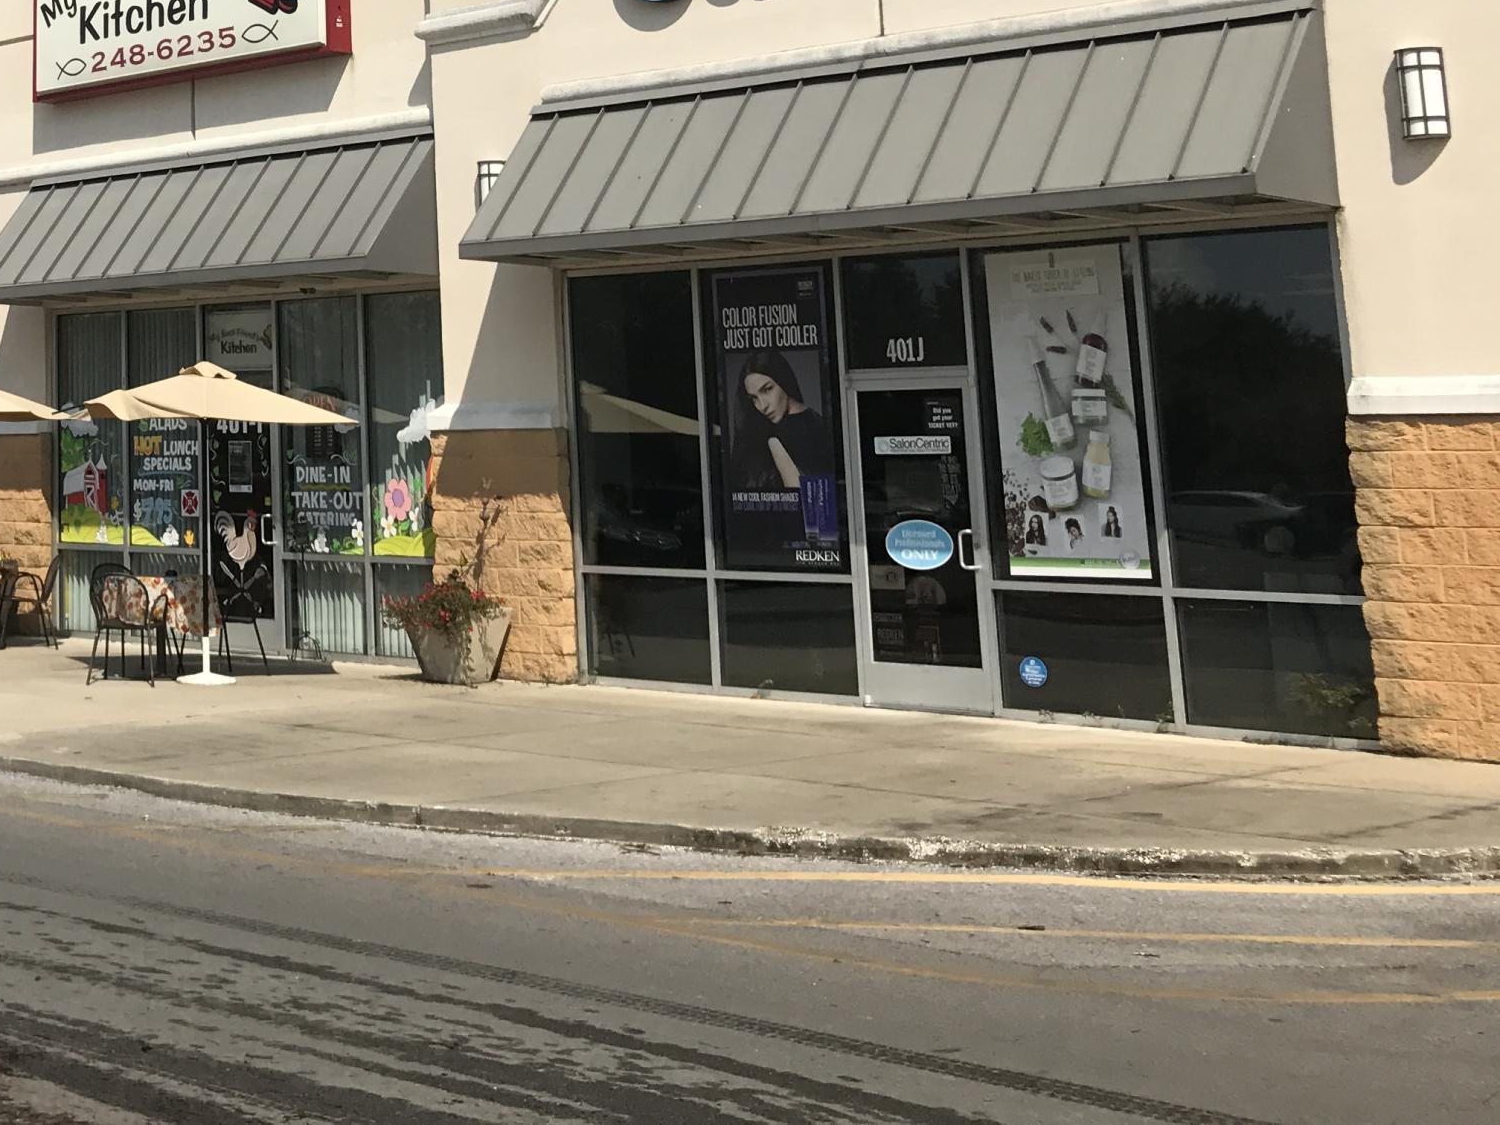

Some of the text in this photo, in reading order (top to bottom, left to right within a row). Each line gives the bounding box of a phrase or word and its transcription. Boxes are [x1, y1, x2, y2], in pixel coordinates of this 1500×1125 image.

[91, 26, 237, 73] 248-6235
[722, 303, 798, 328] COLOR FUSION
[723, 324, 819, 350] JUST GOT COOLER
[220, 339, 258, 355] Kitchen
[886, 336, 925, 363] 401J
[133, 435, 200, 456] HOT LUNCH
[889, 437, 950, 449] SalonCentric
[143, 457, 193, 471] SPECIALS
[295, 465, 352, 484] DINE-IN
[132, 478, 174, 492] MON-FRI
[291, 491, 363, 510] TAKE-OUT
[738, 492, 748, 502] NEW
[748, 492, 760, 502] COOL
[760, 492, 780, 502] FASHION
[901, 530, 937, 538] Licensed
[894, 538, 945, 548] Professionals
[795, 549, 840, 562] REDKEN
[900, 548, 939, 561] ONLY
